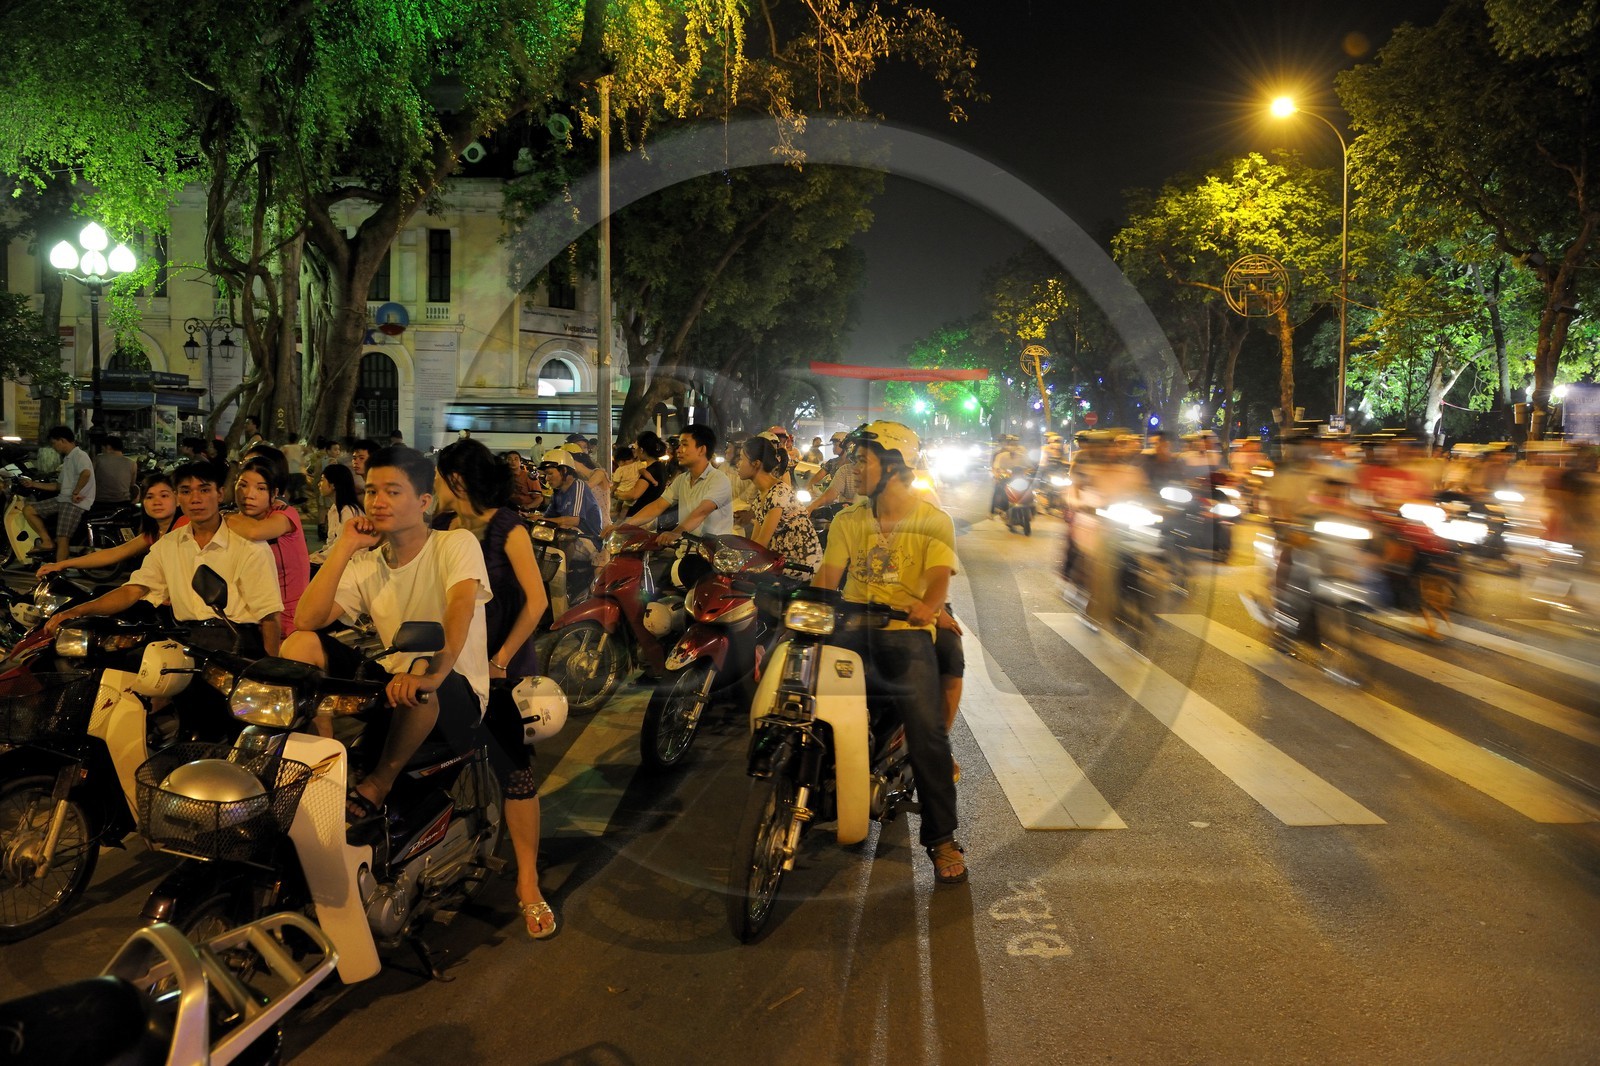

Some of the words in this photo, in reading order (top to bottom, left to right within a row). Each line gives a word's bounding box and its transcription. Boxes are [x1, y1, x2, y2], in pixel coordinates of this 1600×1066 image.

[563, 323, 598, 334] VietinBank
[440, 756, 462, 769] HONDA
[408, 831, 438, 853] Dream
